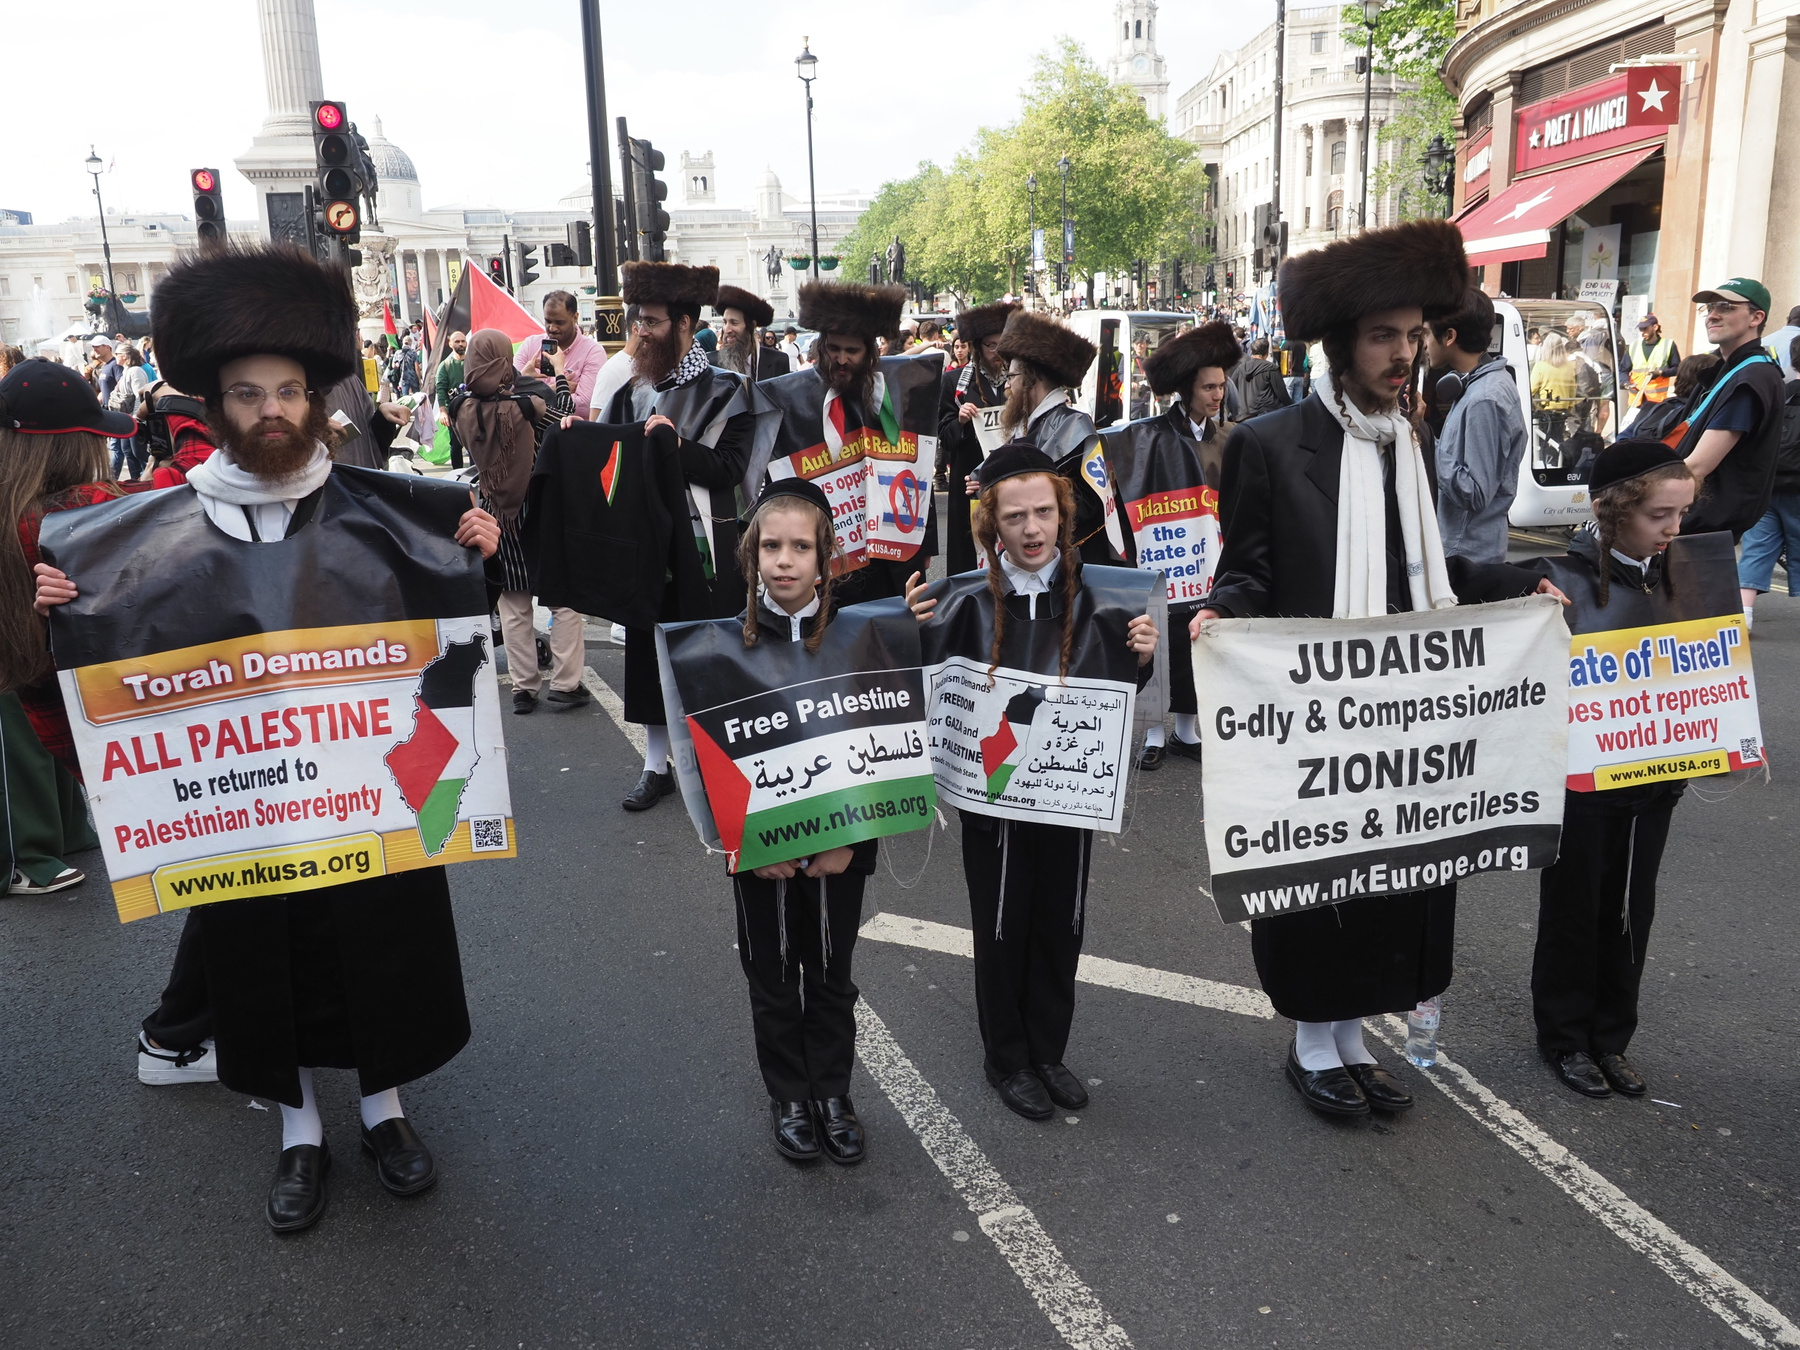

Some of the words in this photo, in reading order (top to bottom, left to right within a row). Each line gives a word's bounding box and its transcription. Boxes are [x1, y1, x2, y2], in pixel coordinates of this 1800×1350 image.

[1544, 113, 1573, 148] PRET
[1571, 111, 1581, 140] A
[801, 434, 871, 475] Autentic
[1567, 473, 1581, 481] eav
[834, 516, 853, 531] and
[848, 524, 864, 543] of
[1152, 526, 1187, 542] the
[1191, 537, 1206, 556] of
[1181, 581, 1202, 598] its
[1288, 627, 1486, 685] JUDAISM
[1625, 640, 1652, 680] of
[1659, 629, 1738, 674] "Israel"
[122, 659, 233, 701] Torah
[242, 639, 408, 680] Demands
[939, 692, 975, 713] FREEDOM
[1046, 693, 1079, 707] تطالب
[1081, 695, 1121, 712] اليهودية
[1609, 690, 1652, 719] not
[1657, 675, 1750, 715] represent
[724, 710, 789, 744] Free
[795, 687, 911, 724] Palestine
[1051, 710, 1102, 734] الحرية
[1216, 703, 1294, 745] G-dly
[1305, 699, 1327, 734] &
[1338, 677, 1547, 732] Compassionate
[945, 715, 963, 733] GAZA
[963, 727, 979, 738] and
[1595, 720, 1658, 752] world
[1662, 717, 1719, 744] Jewry
[102, 731, 181, 782] ALL
[186, 698, 393, 763] PALESTINE
[942, 737, 983, 764] PALESTINE
[1042, 740, 1052, 750] و
[1056, 736, 1079, 751] غزة
[1083, 740, 1104, 756] إلى
[847, 729, 924, 777] فلسطين
[1028, 755, 1088, 775] فلسطين
[173, 778, 202, 802] be
[208, 759, 289, 796] returned
[295, 757, 318, 782] to
[753, 755, 832, 798] عربية
[1093, 761, 1114, 779] كل
[1297, 738, 1478, 799] ZIONISM
[1610, 757, 1721, 782] www.NKUSA.org
[1014, 779, 1042, 789] لليهود
[1044, 777, 1064, 791] دولة
[1081, 786, 1105, 796] تحرم
[1107, 790, 1114, 798] و
[966, 786, 1036, 807] www.nkusa.org
[114, 804, 250, 853] Palestinian
[254, 784, 383, 826] Sovereignty
[758, 794, 928, 848] www.nkusa.org
[1225, 819, 1349, 858] G-dless
[1361, 808, 1384, 840] &
[1396, 790, 1540, 835] Merciless
[169, 850, 371, 896] www.nkusa.org
[1241, 845, 1530, 916] www.nkEurope.org
